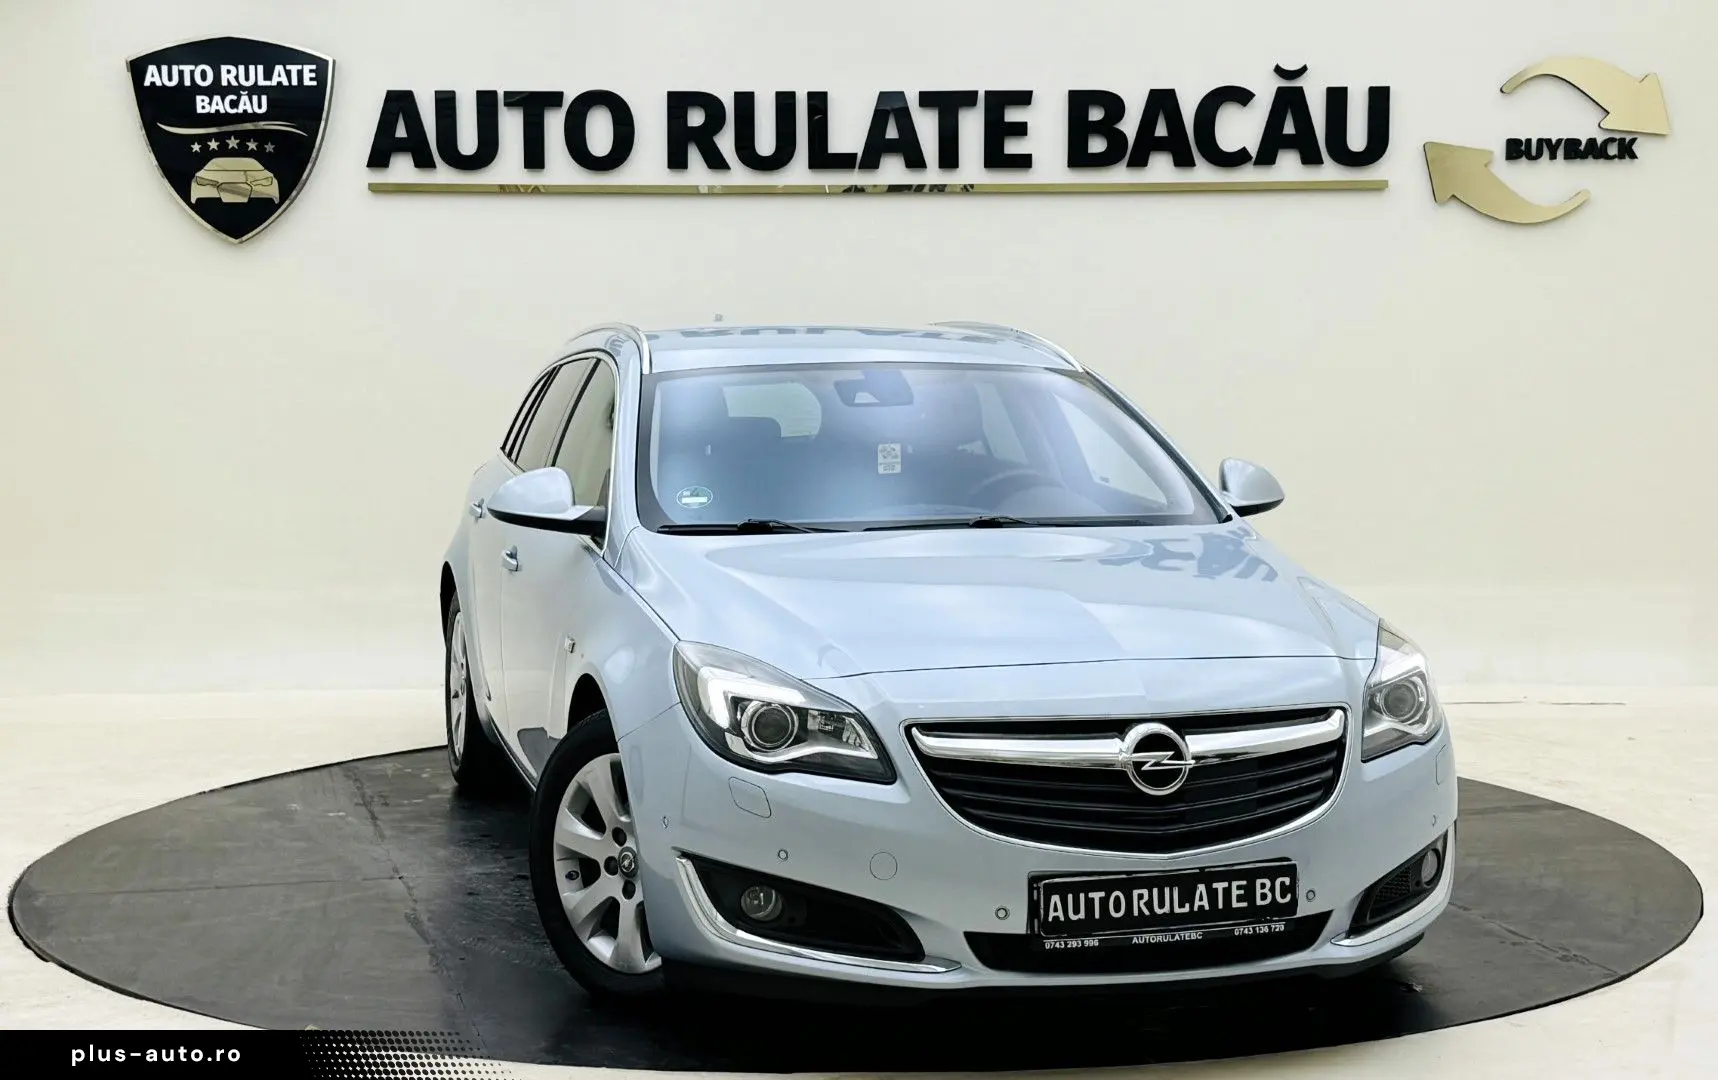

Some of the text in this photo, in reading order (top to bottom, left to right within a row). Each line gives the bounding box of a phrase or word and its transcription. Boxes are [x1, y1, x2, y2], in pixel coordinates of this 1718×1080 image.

[144, 64, 318, 87] AUTO RULATE
[195, 91, 268, 114] BACĂU
[366, 64, 1390, 171] AUTO RULATE BACĂU
[1505, 137, 1639, 161] BUYBACK
[1254, 877, 1292, 905] BC
[1045, 941, 1065, 949] 0743
[1132, 931, 1203, 944] AUTORULATEBC
